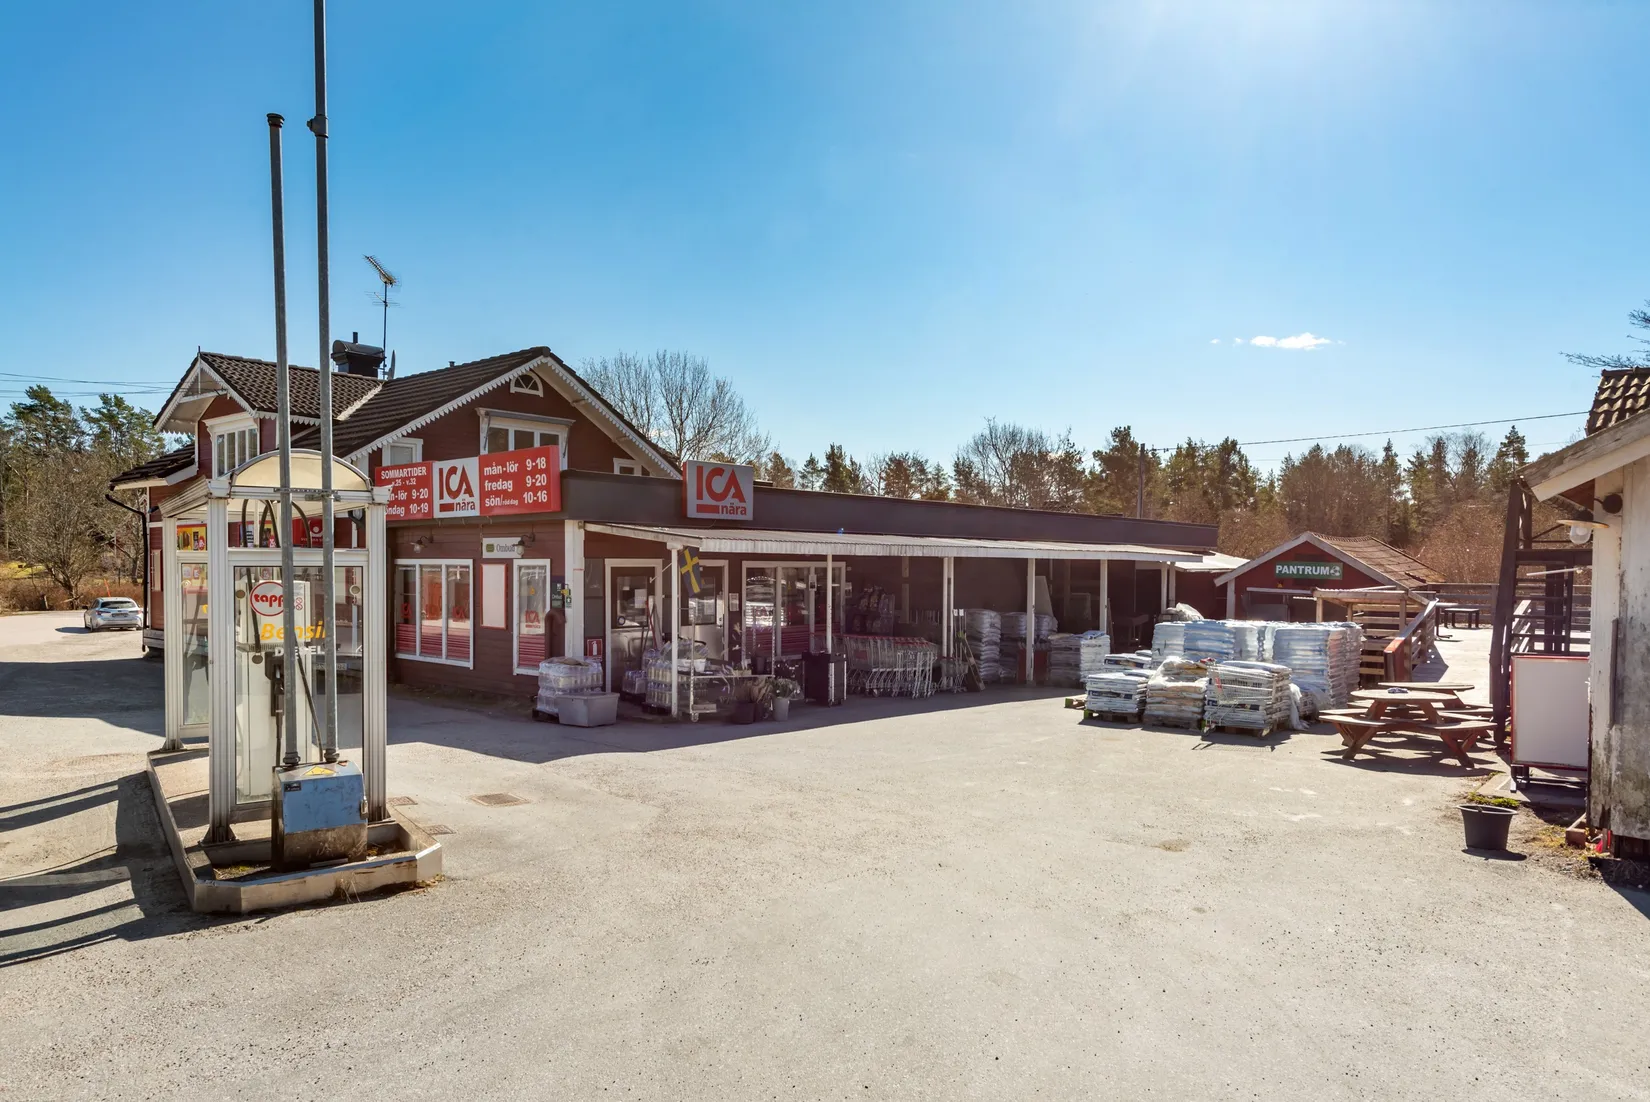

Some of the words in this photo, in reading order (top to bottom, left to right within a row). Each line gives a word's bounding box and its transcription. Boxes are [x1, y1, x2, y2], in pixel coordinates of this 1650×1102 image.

[526, 457, 547, 471] 9-18
[381, 466, 427, 480] SOMMARTIDER
[438, 464, 475, 500] ICA
[484, 479, 513, 492] fredag
[526, 473, 547, 487] 9-20
[696, 465, 746, 503] ICA
[411, 487, 429, 500] 9-20
[523, 490, 548, 504] 10-16
[409, 502, 429, 515] 10-19
[454, 499, 476, 512] nära
[720, 502, 747, 516] nära
[1275, 565, 1330, 576] PANTRUM
